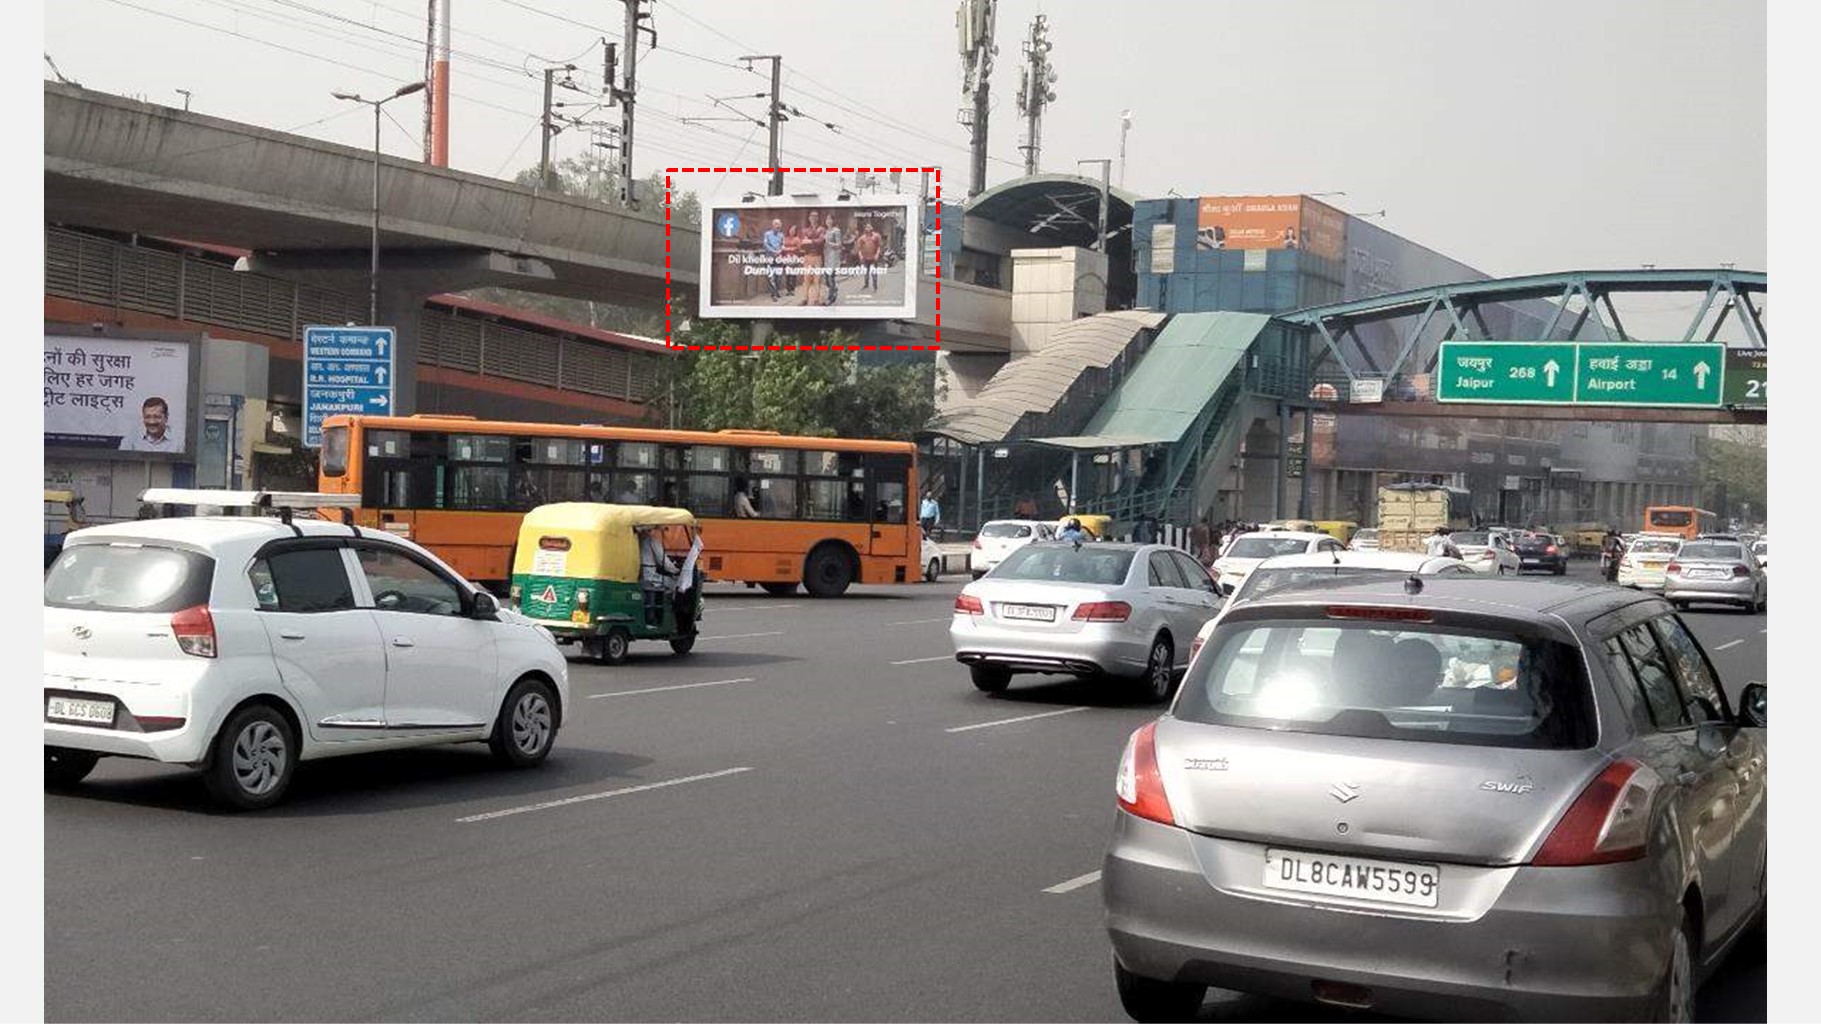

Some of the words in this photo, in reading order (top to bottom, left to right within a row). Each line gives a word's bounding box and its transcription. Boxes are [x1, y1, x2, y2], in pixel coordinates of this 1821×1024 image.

[728, 254, 741, 264] Dil
[775, 254, 805, 264] dekho
[744, 265, 783, 277] Duniya
[785, 265, 833, 275] tumhare
[835, 265, 867, 275] saath
[869, 264, 888, 275] hai
[66, 347, 86, 366] की
[91, 353, 132, 373] सुरक्षा
[1456, 357, 1493, 373] जयपुर
[1588, 354, 1620, 372] हवाई
[75, 373, 93, 388] हर
[98, 374, 136, 390] जगह
[1661, 368, 1677, 380] 14
[1456, 376, 1494, 390] Jaipur
[1587, 377, 1636, 392] Airport
[70, 393, 124, 413] लाइट्स
[1280, 857, 1433, 897] DL8CAW5599
